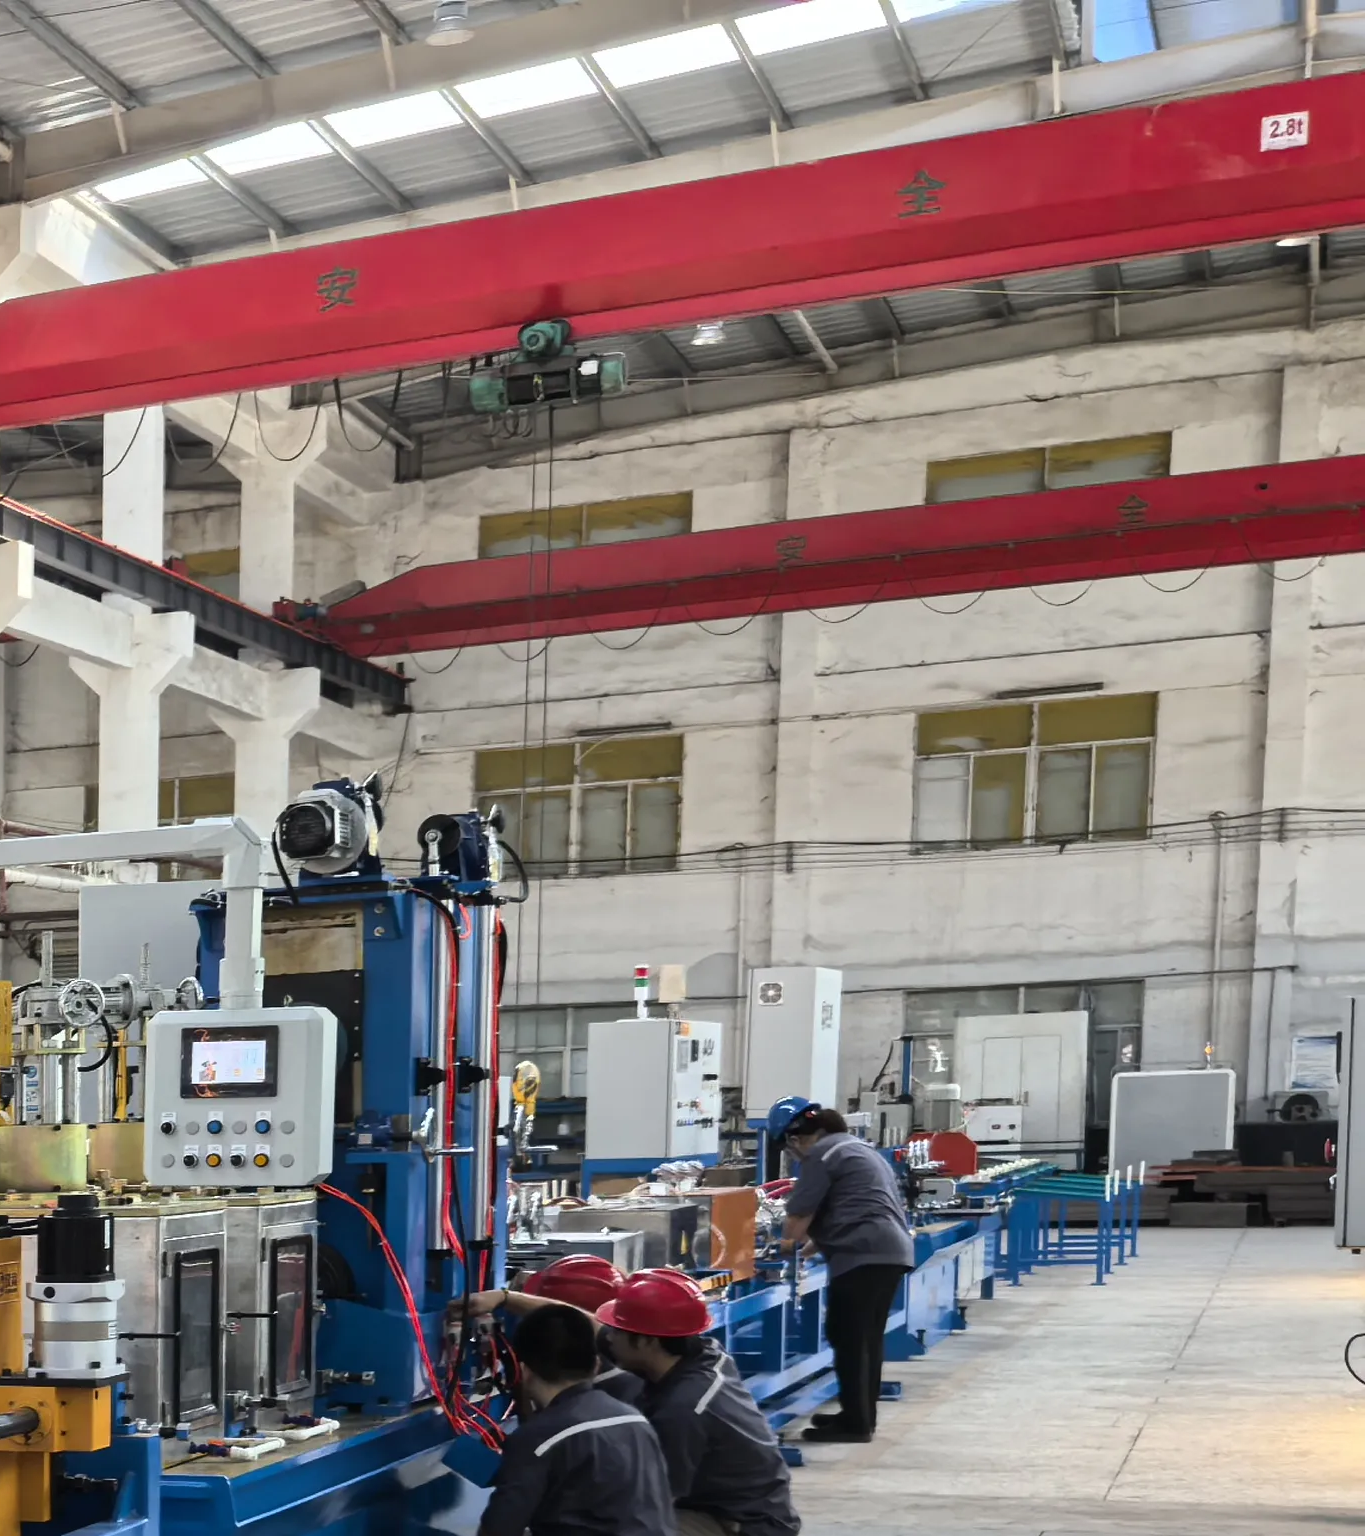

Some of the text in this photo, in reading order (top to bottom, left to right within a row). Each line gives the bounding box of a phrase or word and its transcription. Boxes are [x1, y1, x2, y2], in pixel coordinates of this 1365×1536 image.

[1269, 117, 1304, 139] 2.8t
[315, 169, 948, 312] 安 全
[1117, 493, 1150, 527] 全
